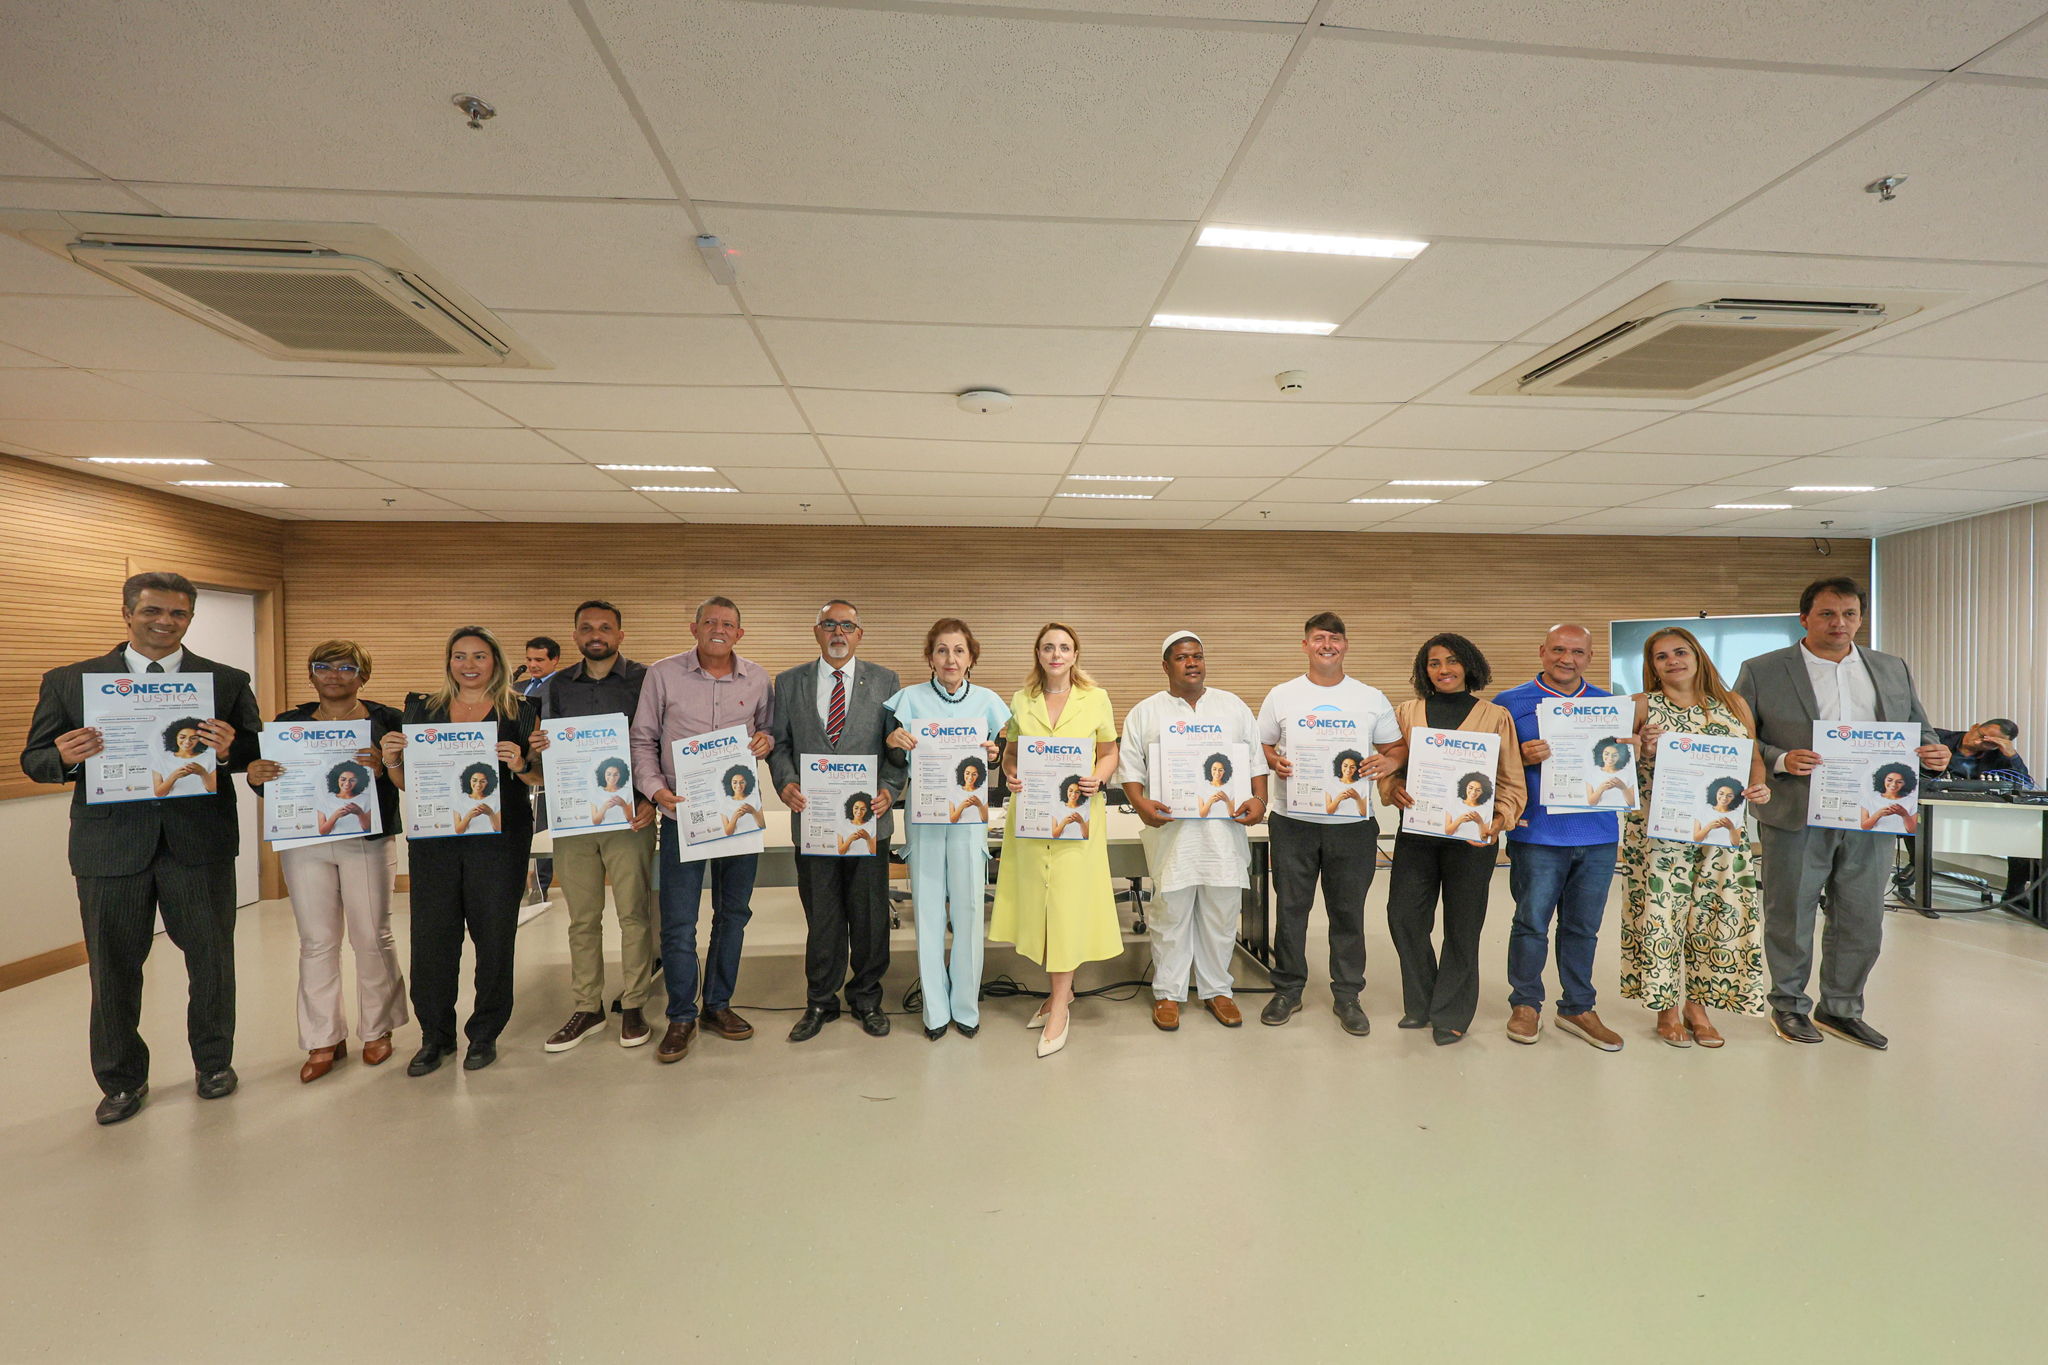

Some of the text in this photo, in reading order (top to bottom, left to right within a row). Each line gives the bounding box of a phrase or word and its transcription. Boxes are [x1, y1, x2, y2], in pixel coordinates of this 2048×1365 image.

[101, 683, 198, 697] CONECTA
[133, 694, 198, 703] JUSTIÇA
[1553, 706, 1619, 717] CONECTA
[1298, 718, 1356, 730] CONECTA
[1572, 716, 1619, 724] JUSTIÇA
[557, 728, 617, 742] CONECTA
[921, 726, 978, 738] CONECTA
[1169, 724, 1222, 735] CONECTA
[1826, 730, 1906, 741] CONECTA
[278, 730, 356, 743] CONECTA
[415, 731, 485, 744] CONECTA
[938, 736, 978, 744] JUSTIÇA
[303, 739, 357, 748] JUSTIÇA
[438, 740, 485, 750] JUSTIÇA
[682, 736, 738, 755] CONECTA
[1027, 744, 1082, 755] CONECTA
[1426, 736, 1487, 752] CONECTA
[1669, 741, 1738, 756] CONECTA
[1850, 740, 1906, 750] JUSTIÇA
[700, 744, 740, 760] JUSTIÇA
[1044, 754, 1082, 762] JUSTIÇA
[1442, 748, 1486, 760] JUSTIÇA
[1689, 752, 1738, 764] JUSTIÇA
[810, 762, 867, 774] CONECTA
[828, 772, 867, 780] JUSTIÇA
